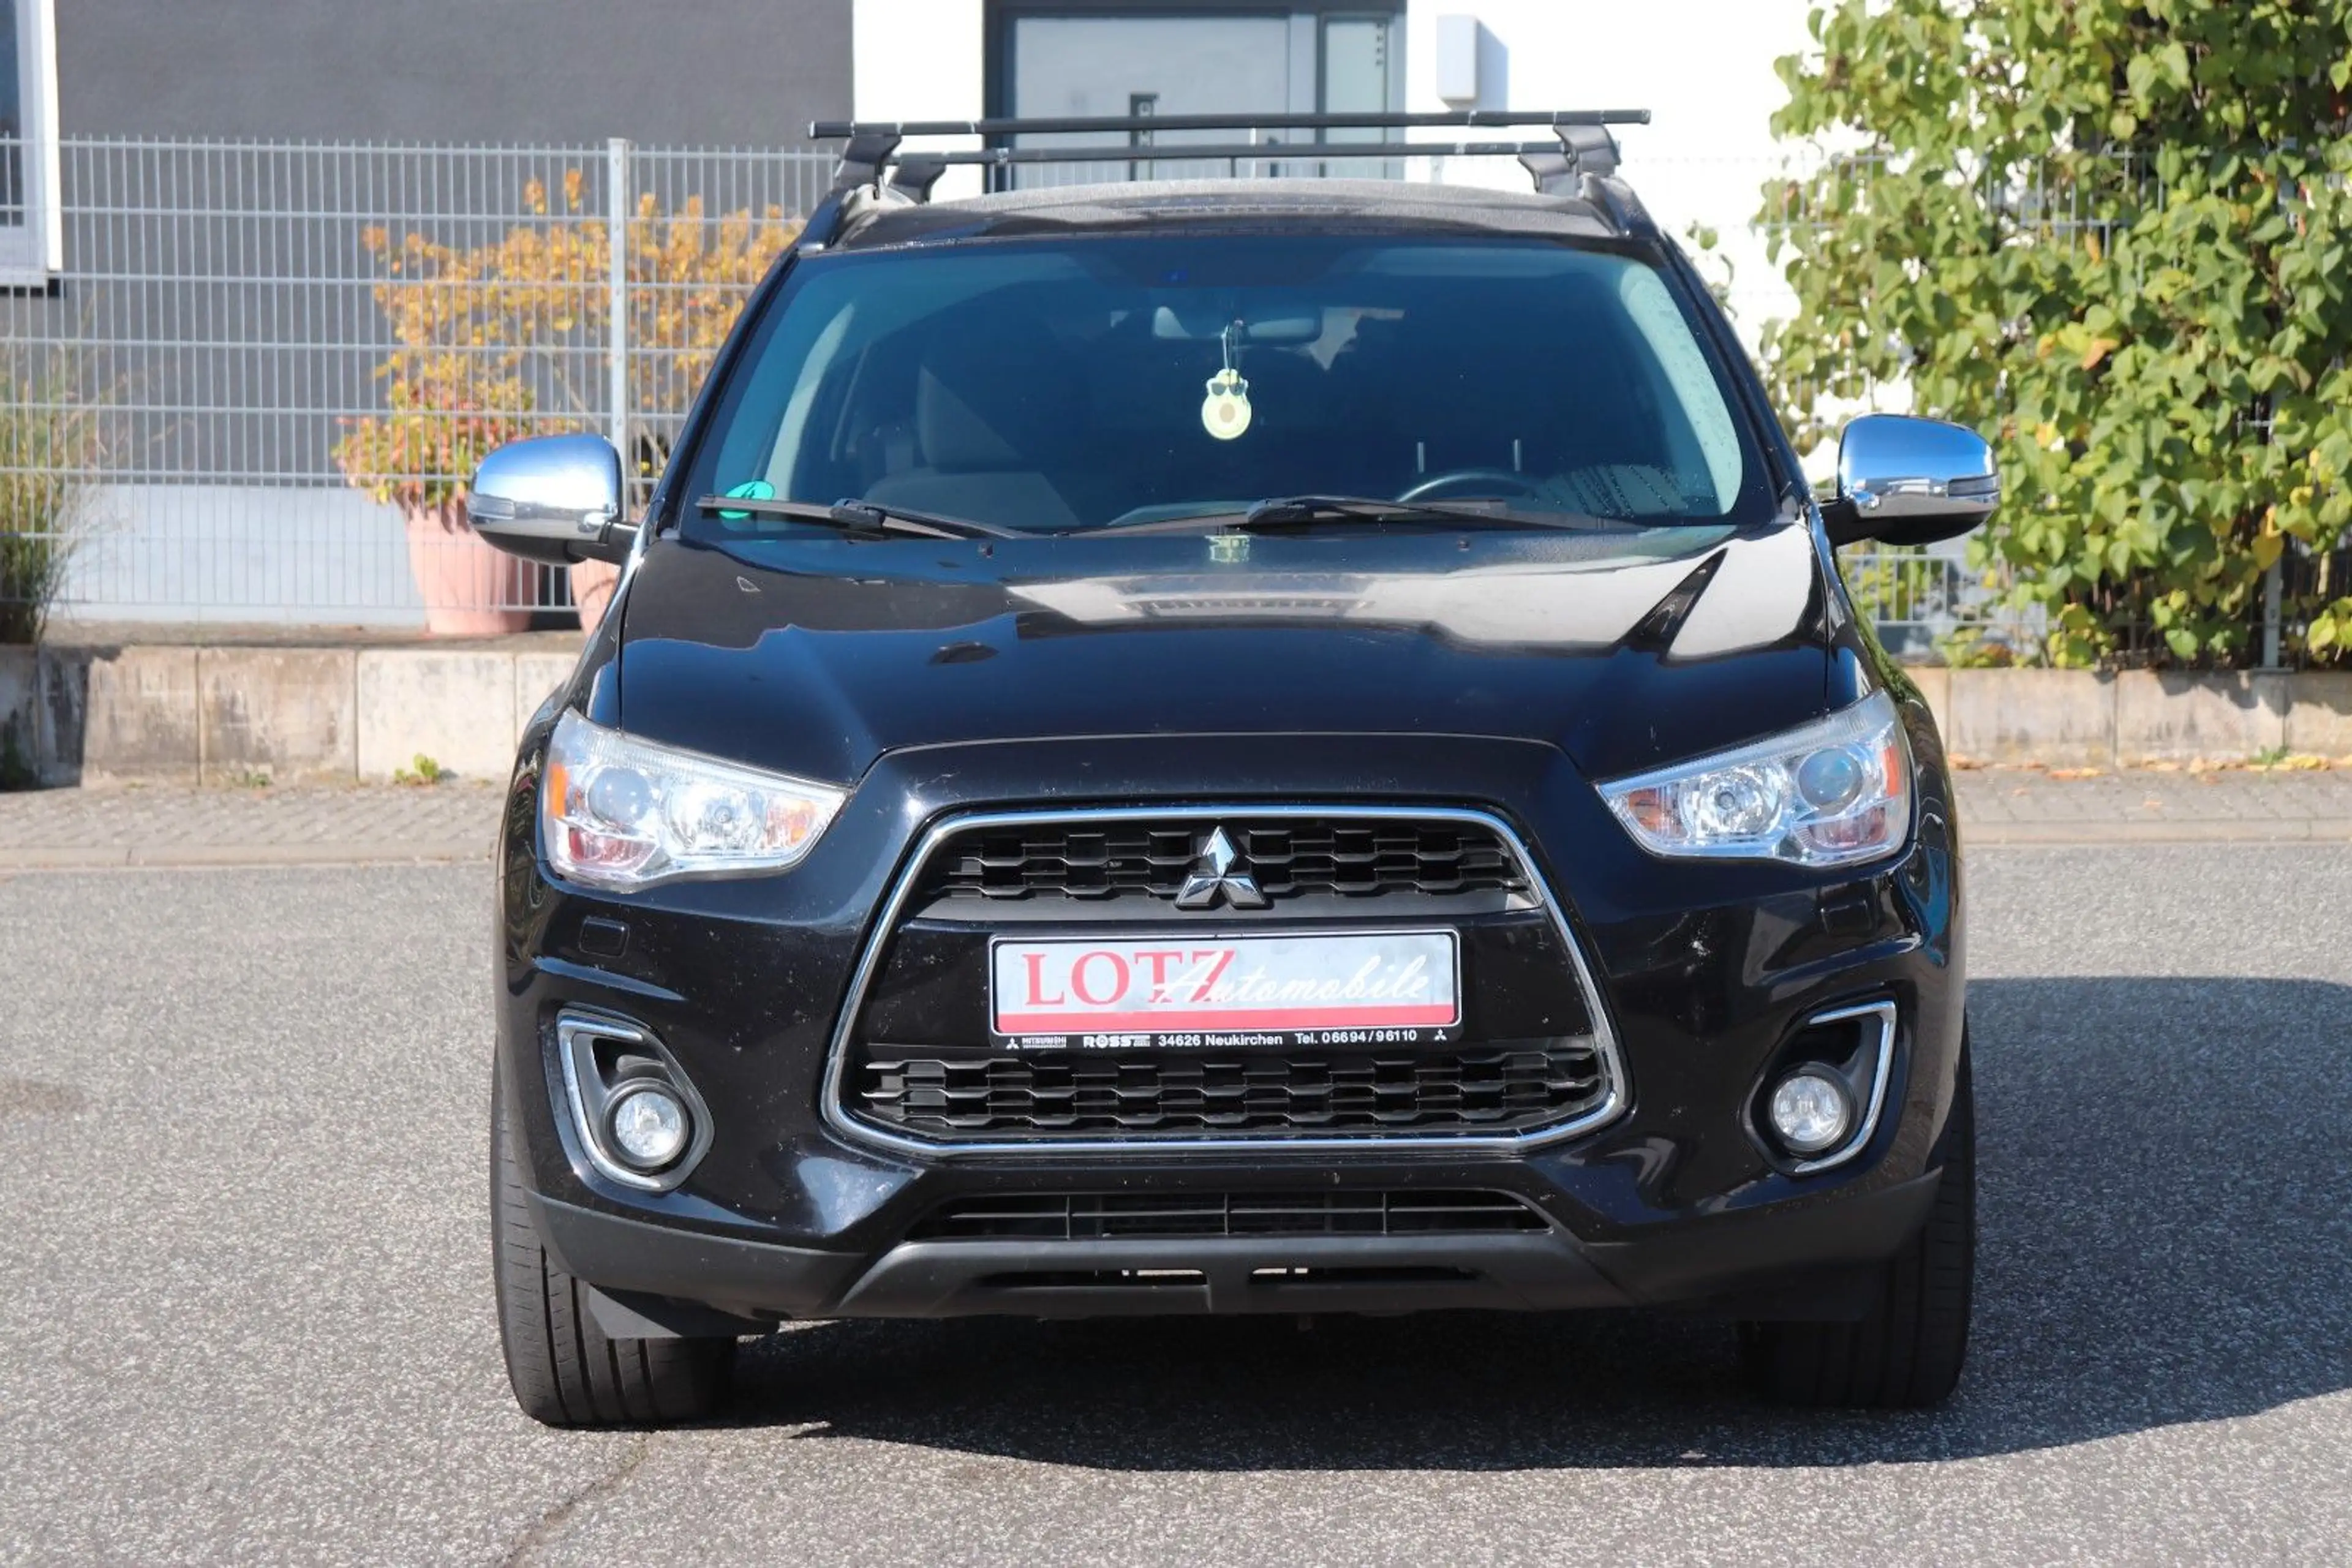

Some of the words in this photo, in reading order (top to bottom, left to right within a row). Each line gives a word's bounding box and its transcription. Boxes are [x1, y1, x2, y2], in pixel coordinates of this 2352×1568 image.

[1021, 950, 1235, 1006] LOTZ
[1153, 951, 1429, 1003] Automobile
[1158, 1034, 1201, 1047] 34626
[1205, 1033, 1283, 1046] Neukirchen
[1294, 1032, 1318, 1044] Tel.
[1321, 1030, 1417, 1043] 06694/96110
